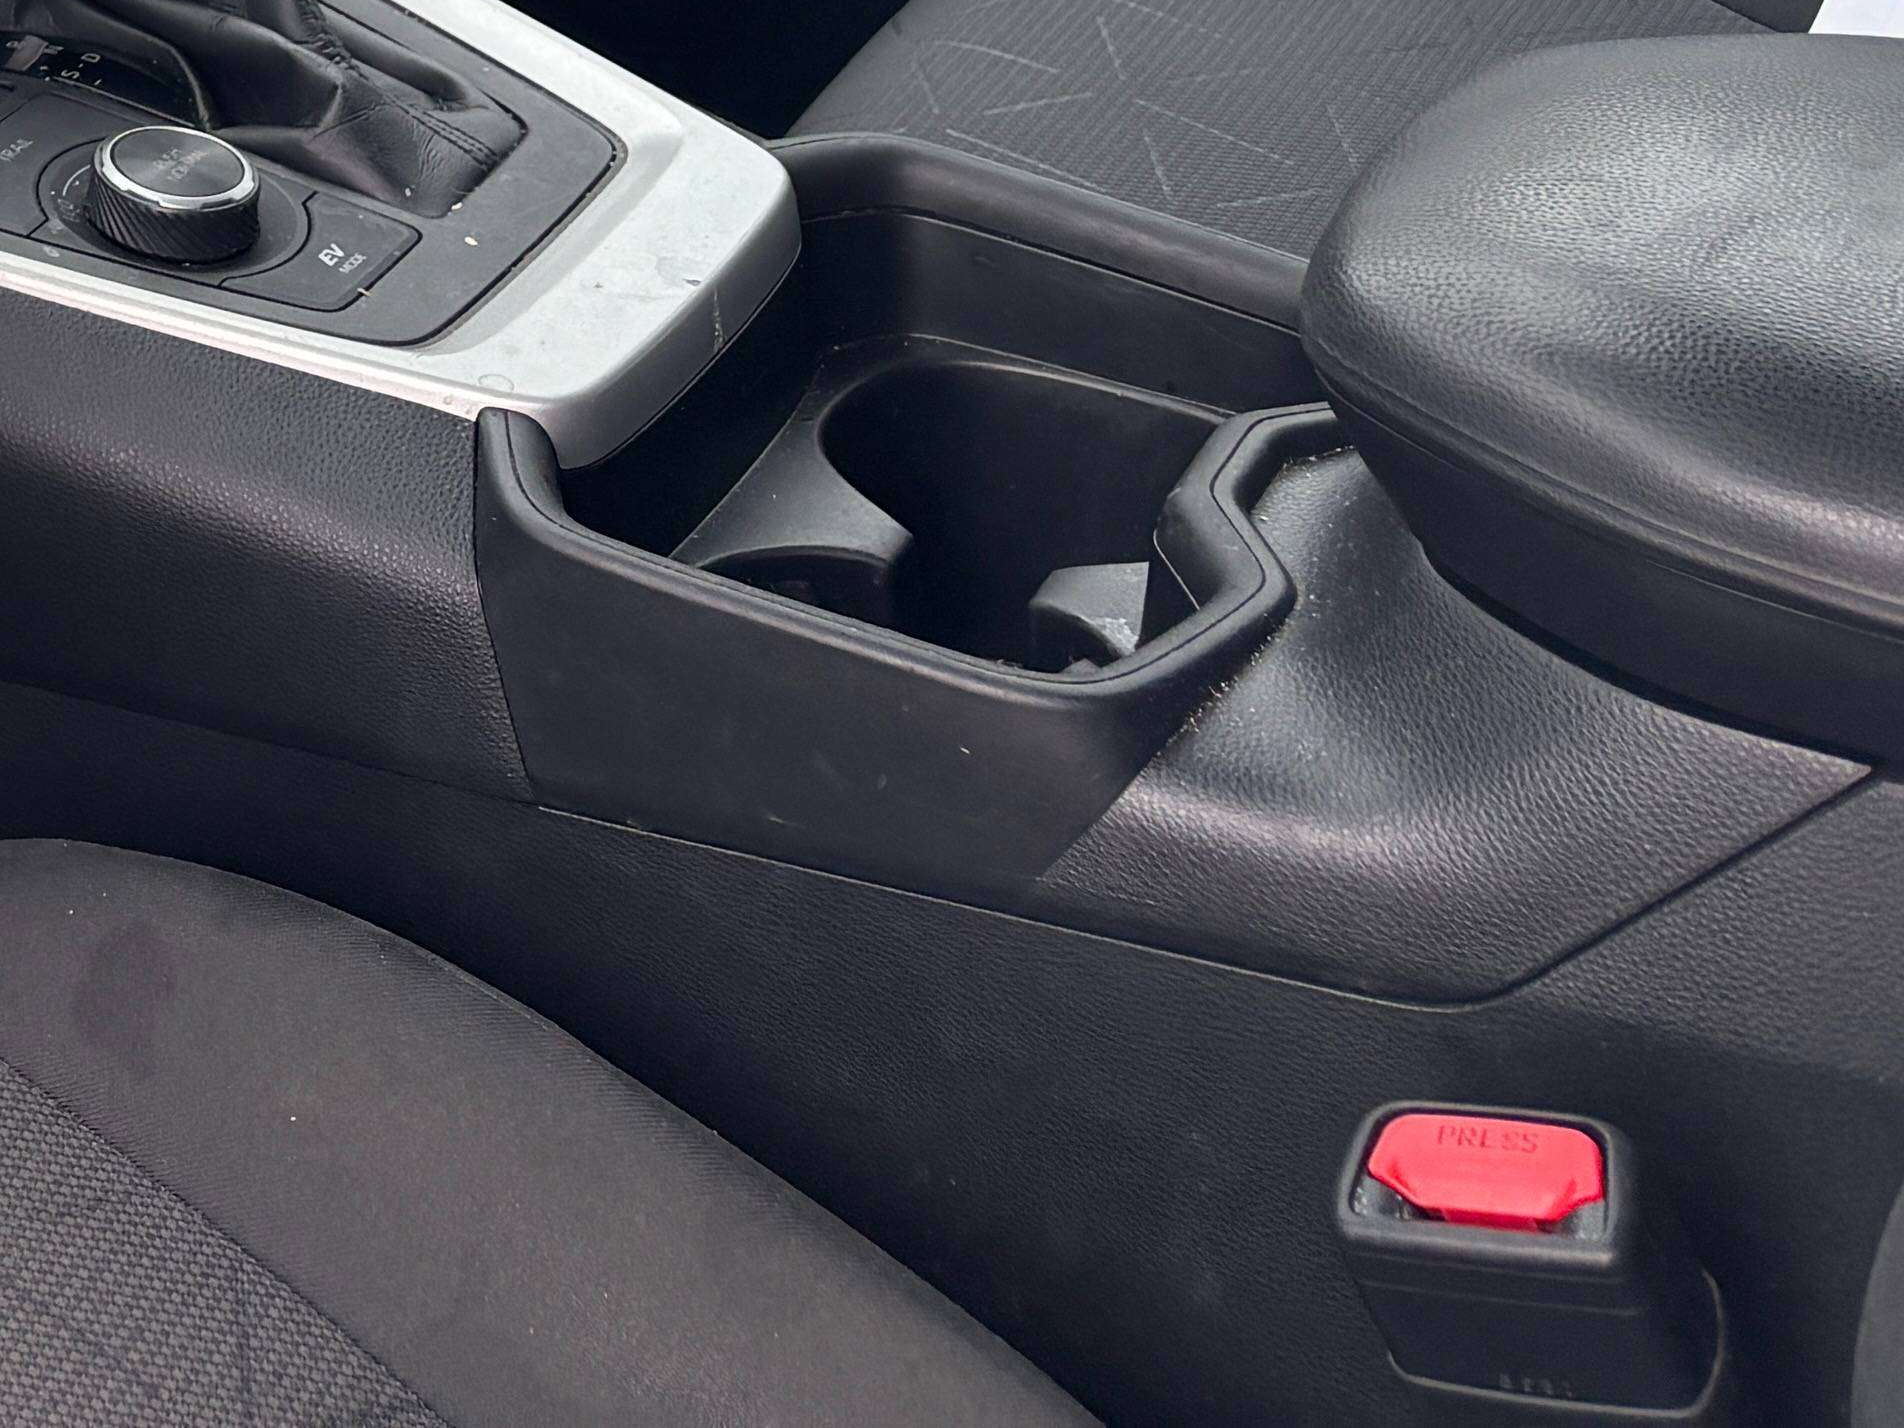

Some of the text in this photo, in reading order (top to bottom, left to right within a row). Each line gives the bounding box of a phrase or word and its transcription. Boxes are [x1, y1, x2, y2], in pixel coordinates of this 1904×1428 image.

[318, 243, 345, 266] EV
[339, 252, 367, 274] MODE
[1436, 1125, 1539, 1154] PRESS
